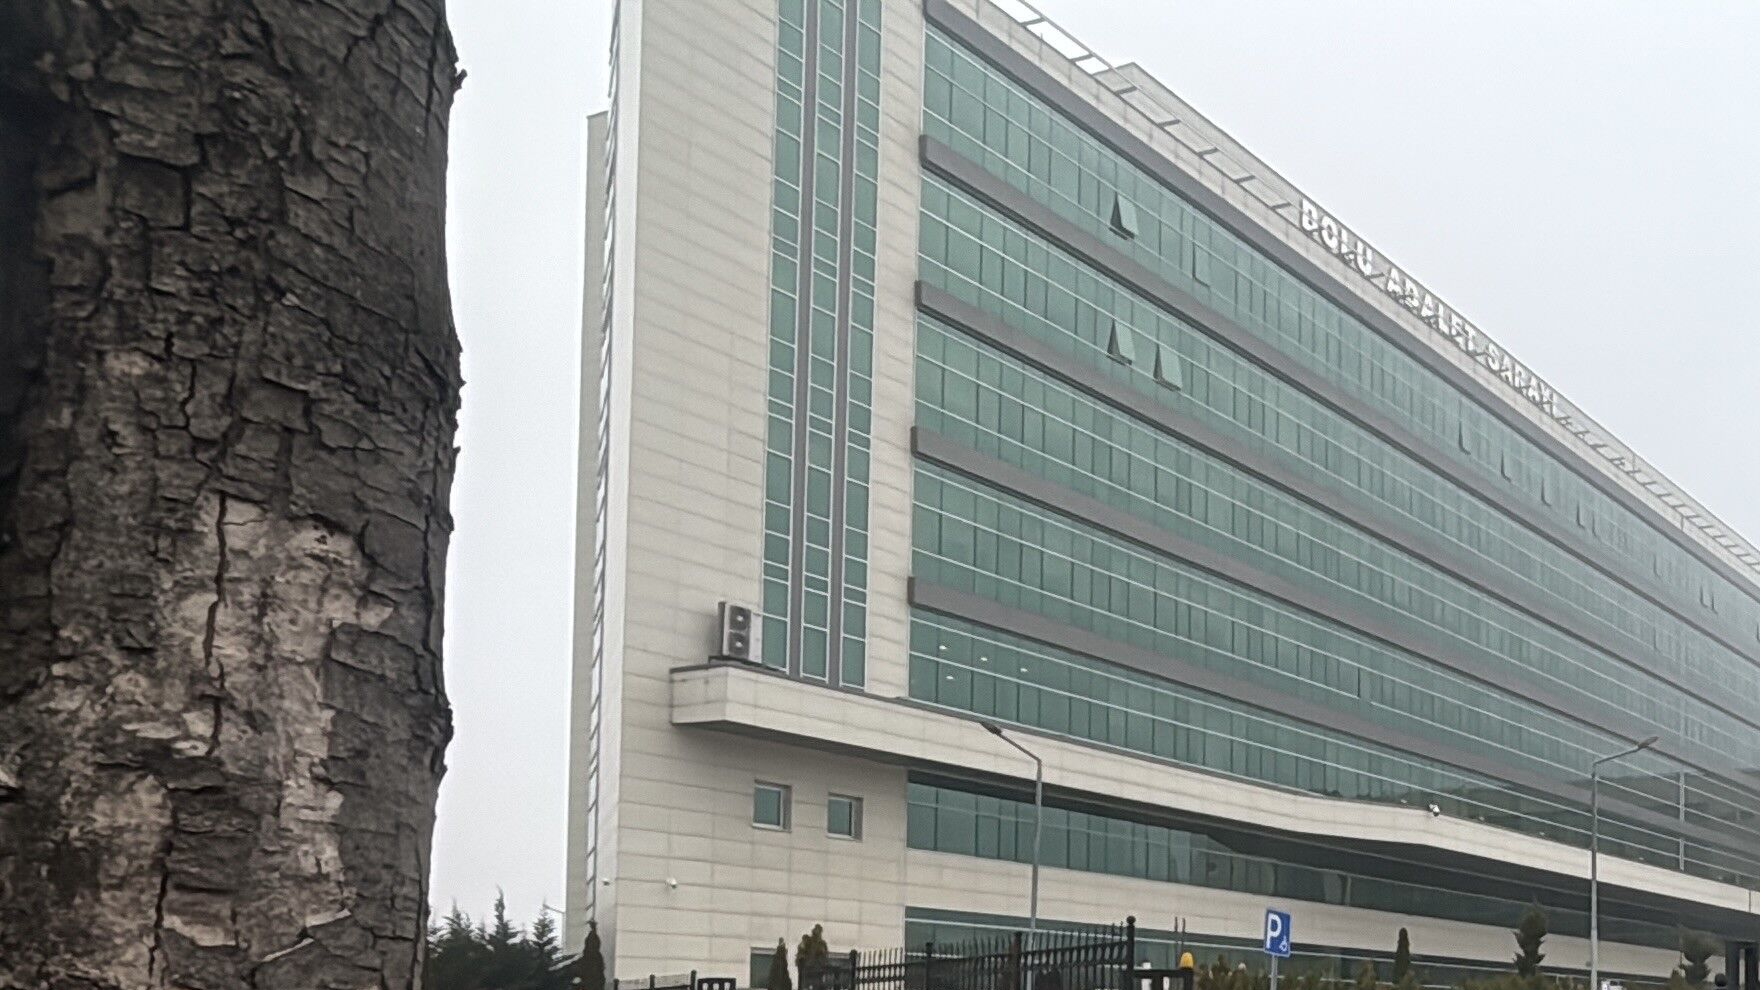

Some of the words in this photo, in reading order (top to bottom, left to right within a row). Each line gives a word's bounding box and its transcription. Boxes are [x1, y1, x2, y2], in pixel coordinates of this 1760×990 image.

[1301, 198, 1372, 276] BOLU
[1387, 267, 1476, 352] ADALET
[1266, 912, 1281, 949] P
